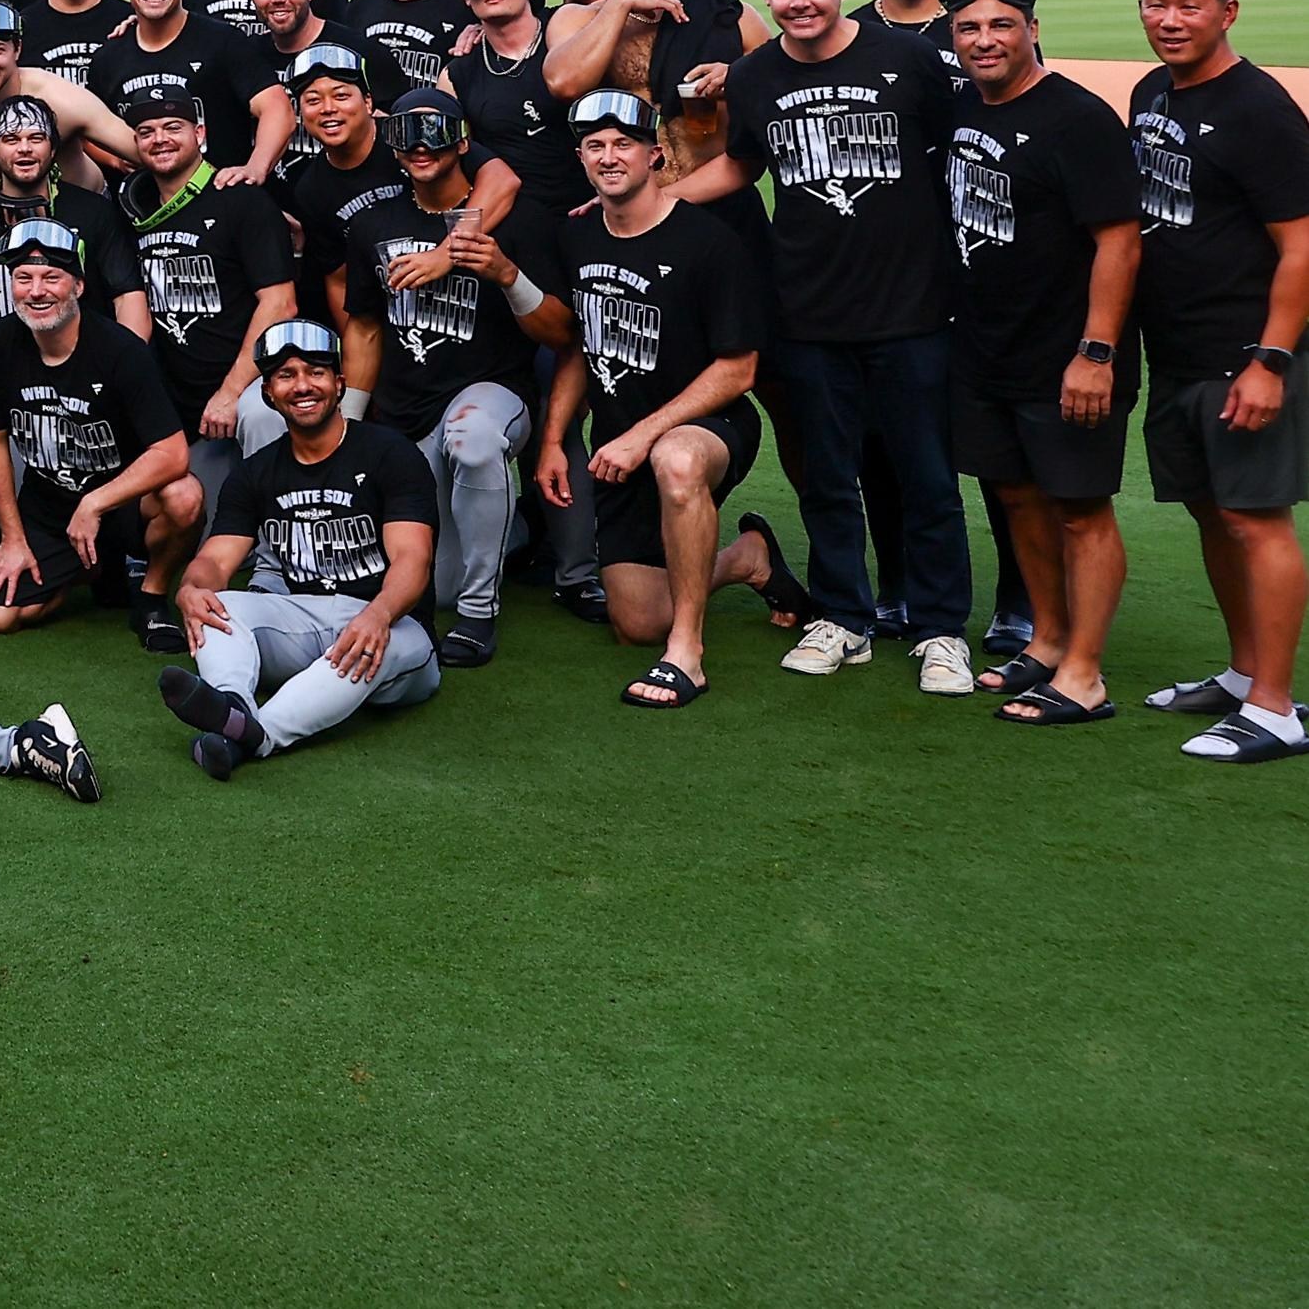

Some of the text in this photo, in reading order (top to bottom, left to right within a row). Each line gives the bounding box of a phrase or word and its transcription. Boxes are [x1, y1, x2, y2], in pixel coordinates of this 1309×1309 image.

[776, 86, 879, 111] WHITE SOX
[767, 112, 902, 187] CLINCHED
[580, 264, 650, 294] WHITE SOX
[276, 489, 353, 509] WHITE SOX
